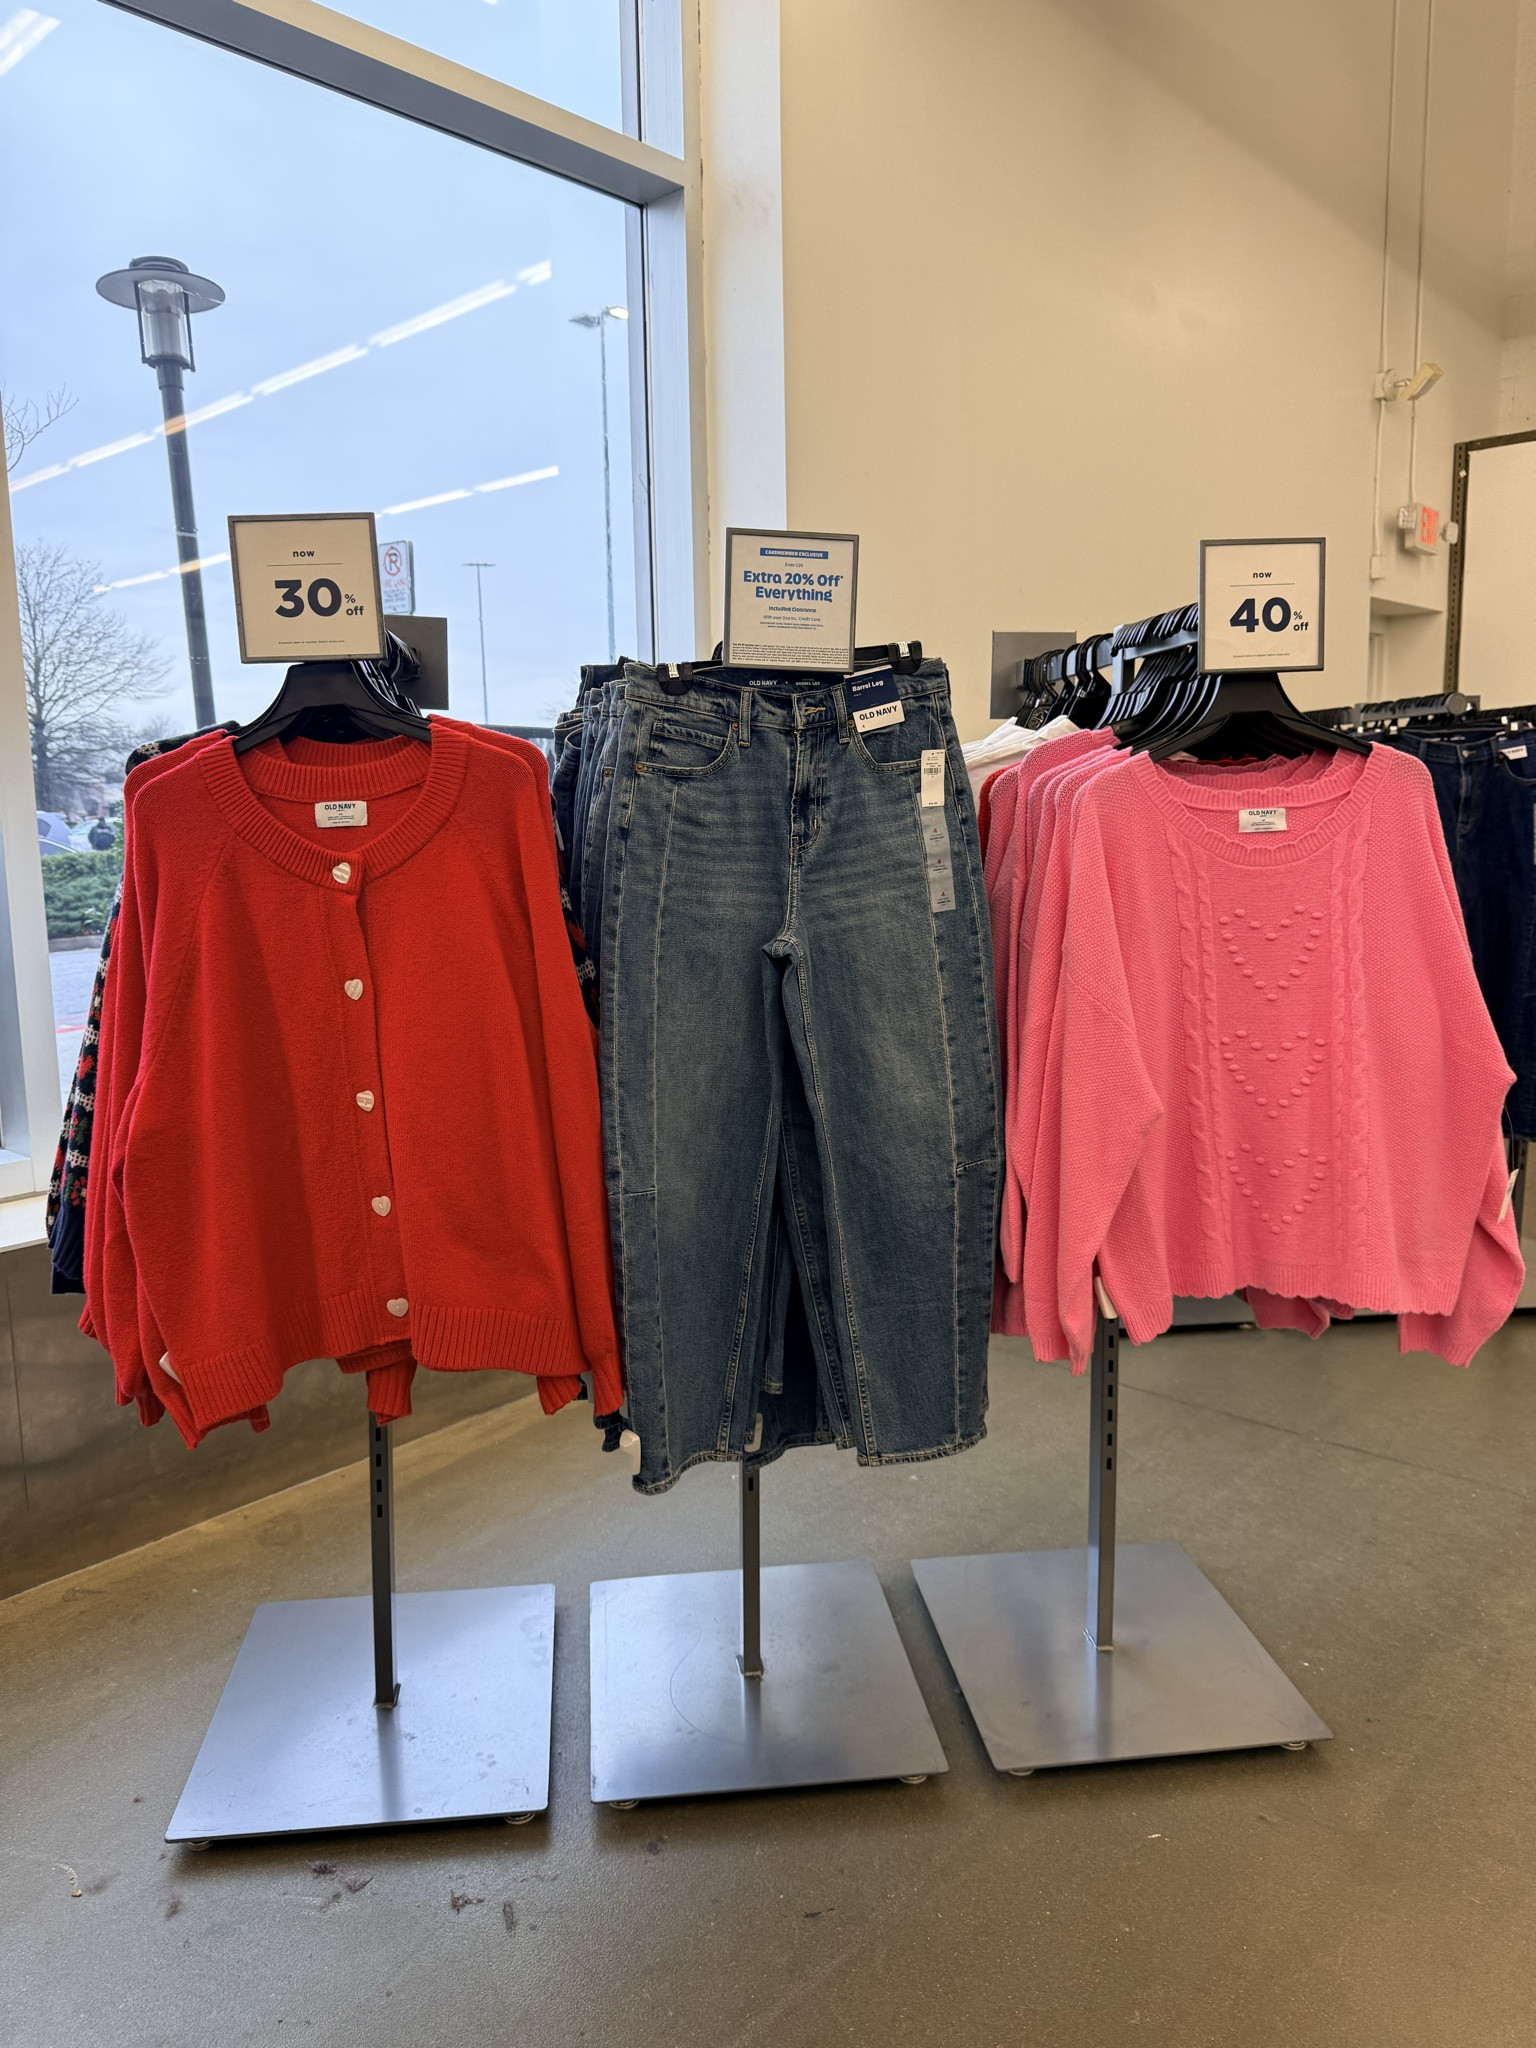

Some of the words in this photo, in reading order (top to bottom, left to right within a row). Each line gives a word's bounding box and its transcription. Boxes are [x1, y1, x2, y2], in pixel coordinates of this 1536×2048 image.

[293, 550, 315, 558] now
[799, 550, 824, 558] EXCLUSIVE
[744, 571, 781, 584] Extra
[784, 572, 814, 586] 20%
[756, 587, 832, 602] Everything
[345, 605, 364, 616] off
[1293, 621, 1309, 631] off
[852, 682, 871, 692] Barrel
[871, 680, 884, 688] Leg
[859, 711, 875, 721] OLD
[876, 705, 898, 717] NAVY
